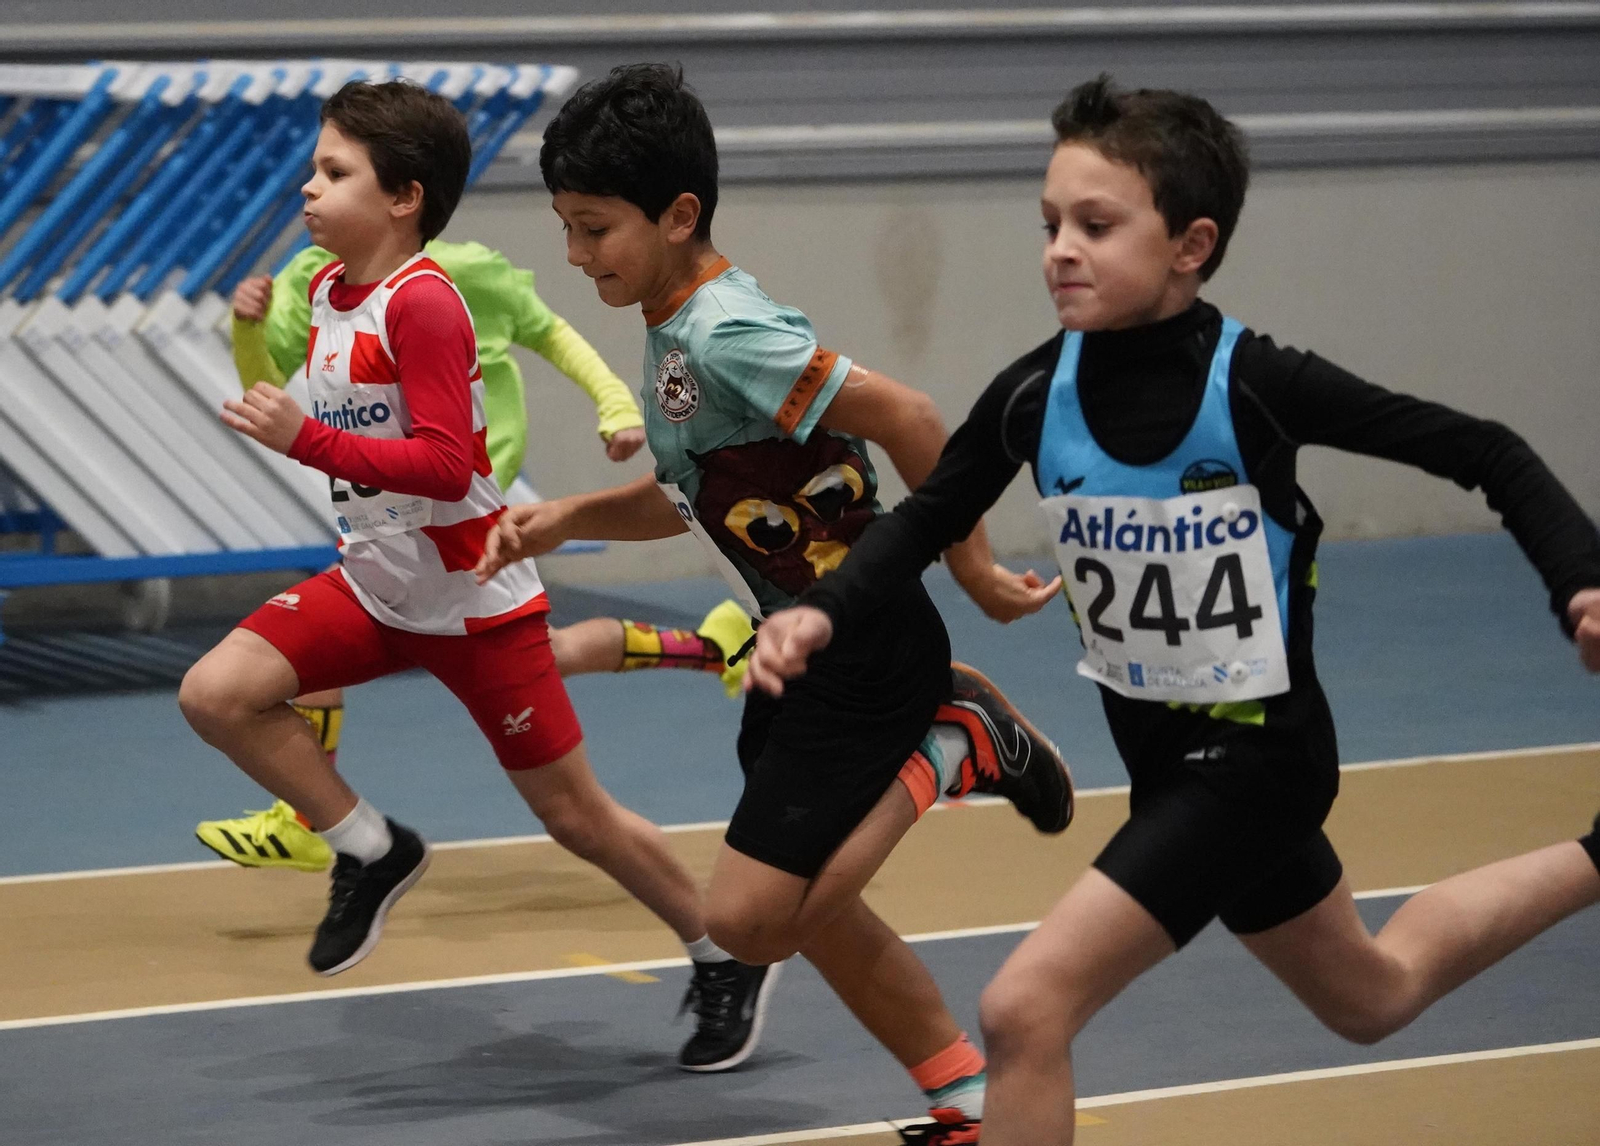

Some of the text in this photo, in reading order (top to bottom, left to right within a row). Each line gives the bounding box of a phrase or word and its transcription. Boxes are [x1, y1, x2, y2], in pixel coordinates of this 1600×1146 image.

[313, 398, 390, 430] lántico
[1059, 504, 1259, 553] Atlántico
[1074, 552, 1263, 647] 244
